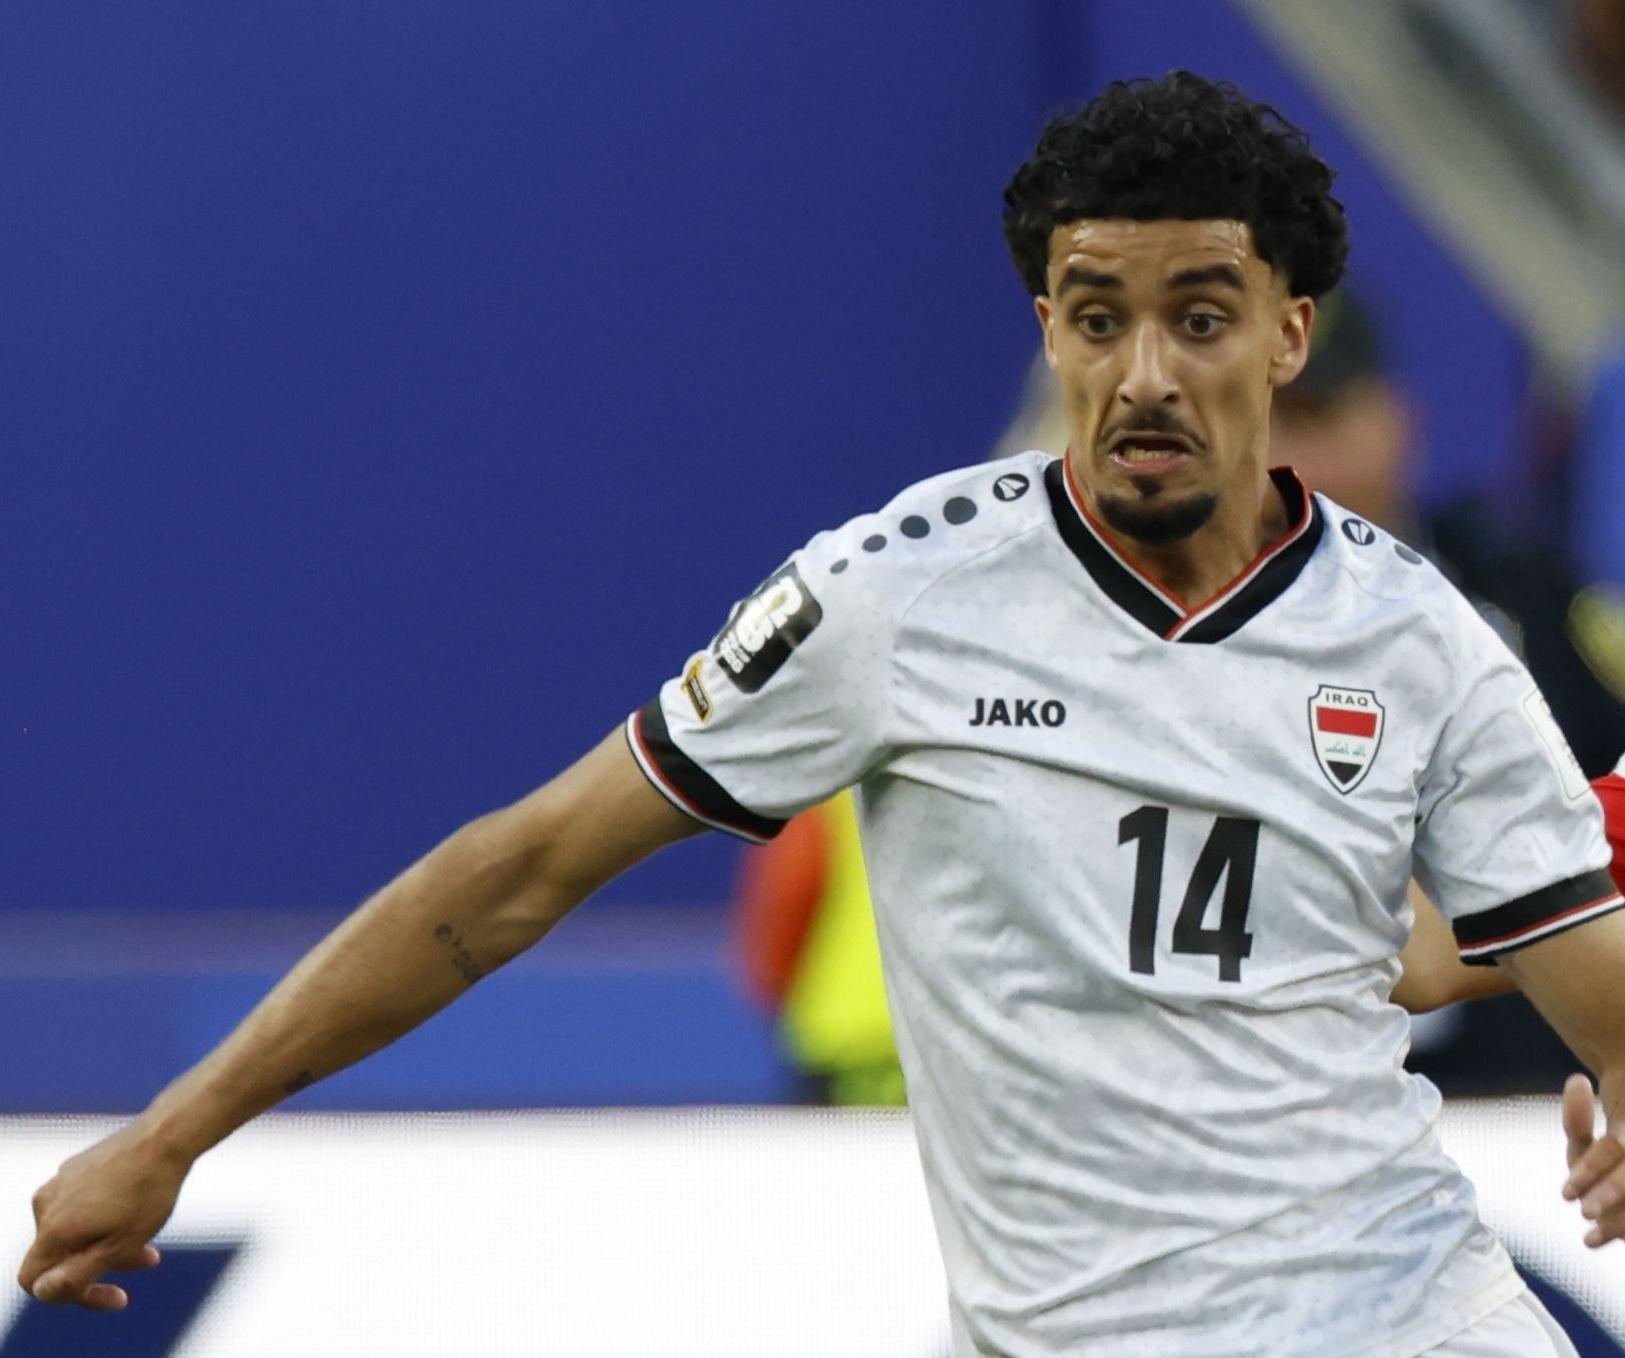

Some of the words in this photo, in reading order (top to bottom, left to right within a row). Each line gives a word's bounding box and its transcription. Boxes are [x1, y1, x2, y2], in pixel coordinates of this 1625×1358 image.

[968, 697, 1067, 728] JAKO
[1325, 693, 1369, 708] IRAQ
[1118, 805, 1261, 983] 14
